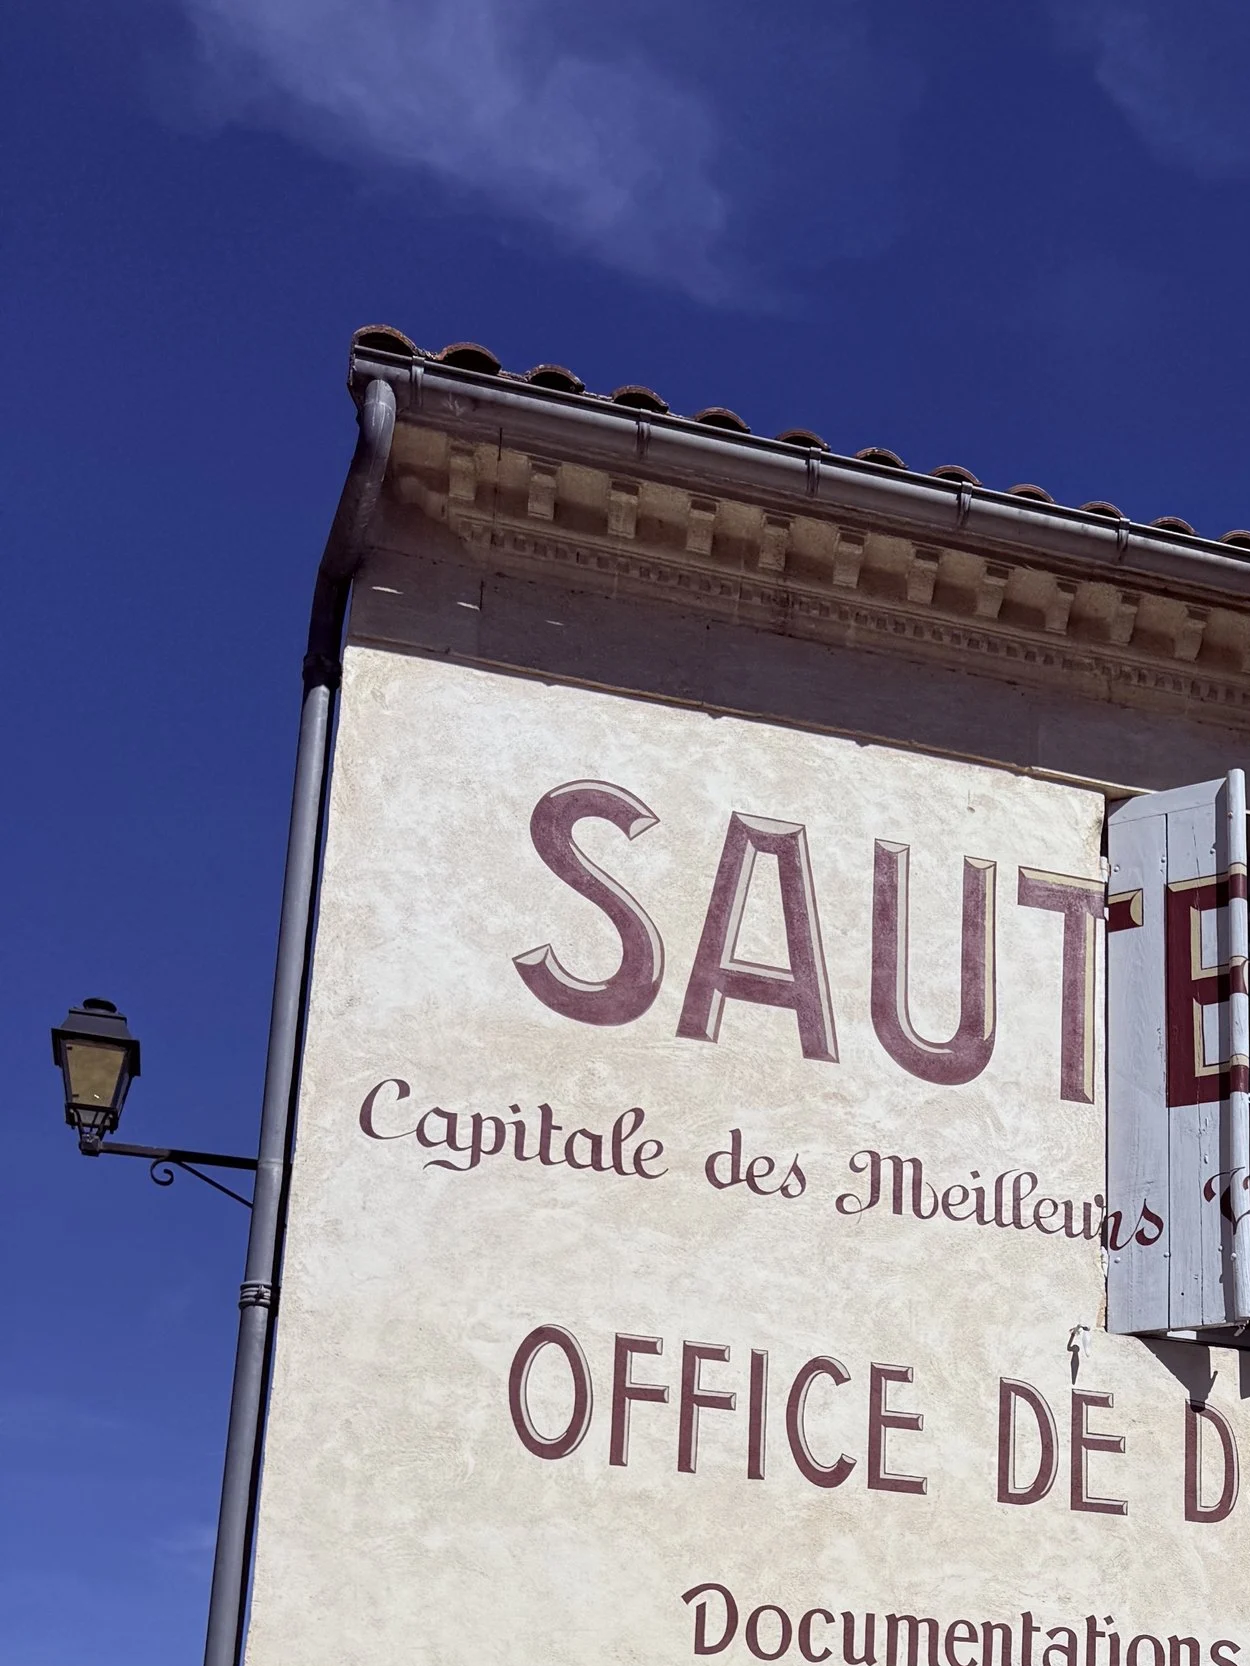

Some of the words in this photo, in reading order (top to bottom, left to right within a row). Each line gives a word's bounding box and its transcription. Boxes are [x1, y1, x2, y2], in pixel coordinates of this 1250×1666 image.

[360, 1078, 668, 1178] Capitale
[705, 1129, 806, 1199] des
[836, 1150, 1164, 1251] Meilleurs
[509, 1323, 928, 1495] OFFICE
[997, 1377, 1128, 1516] DE
